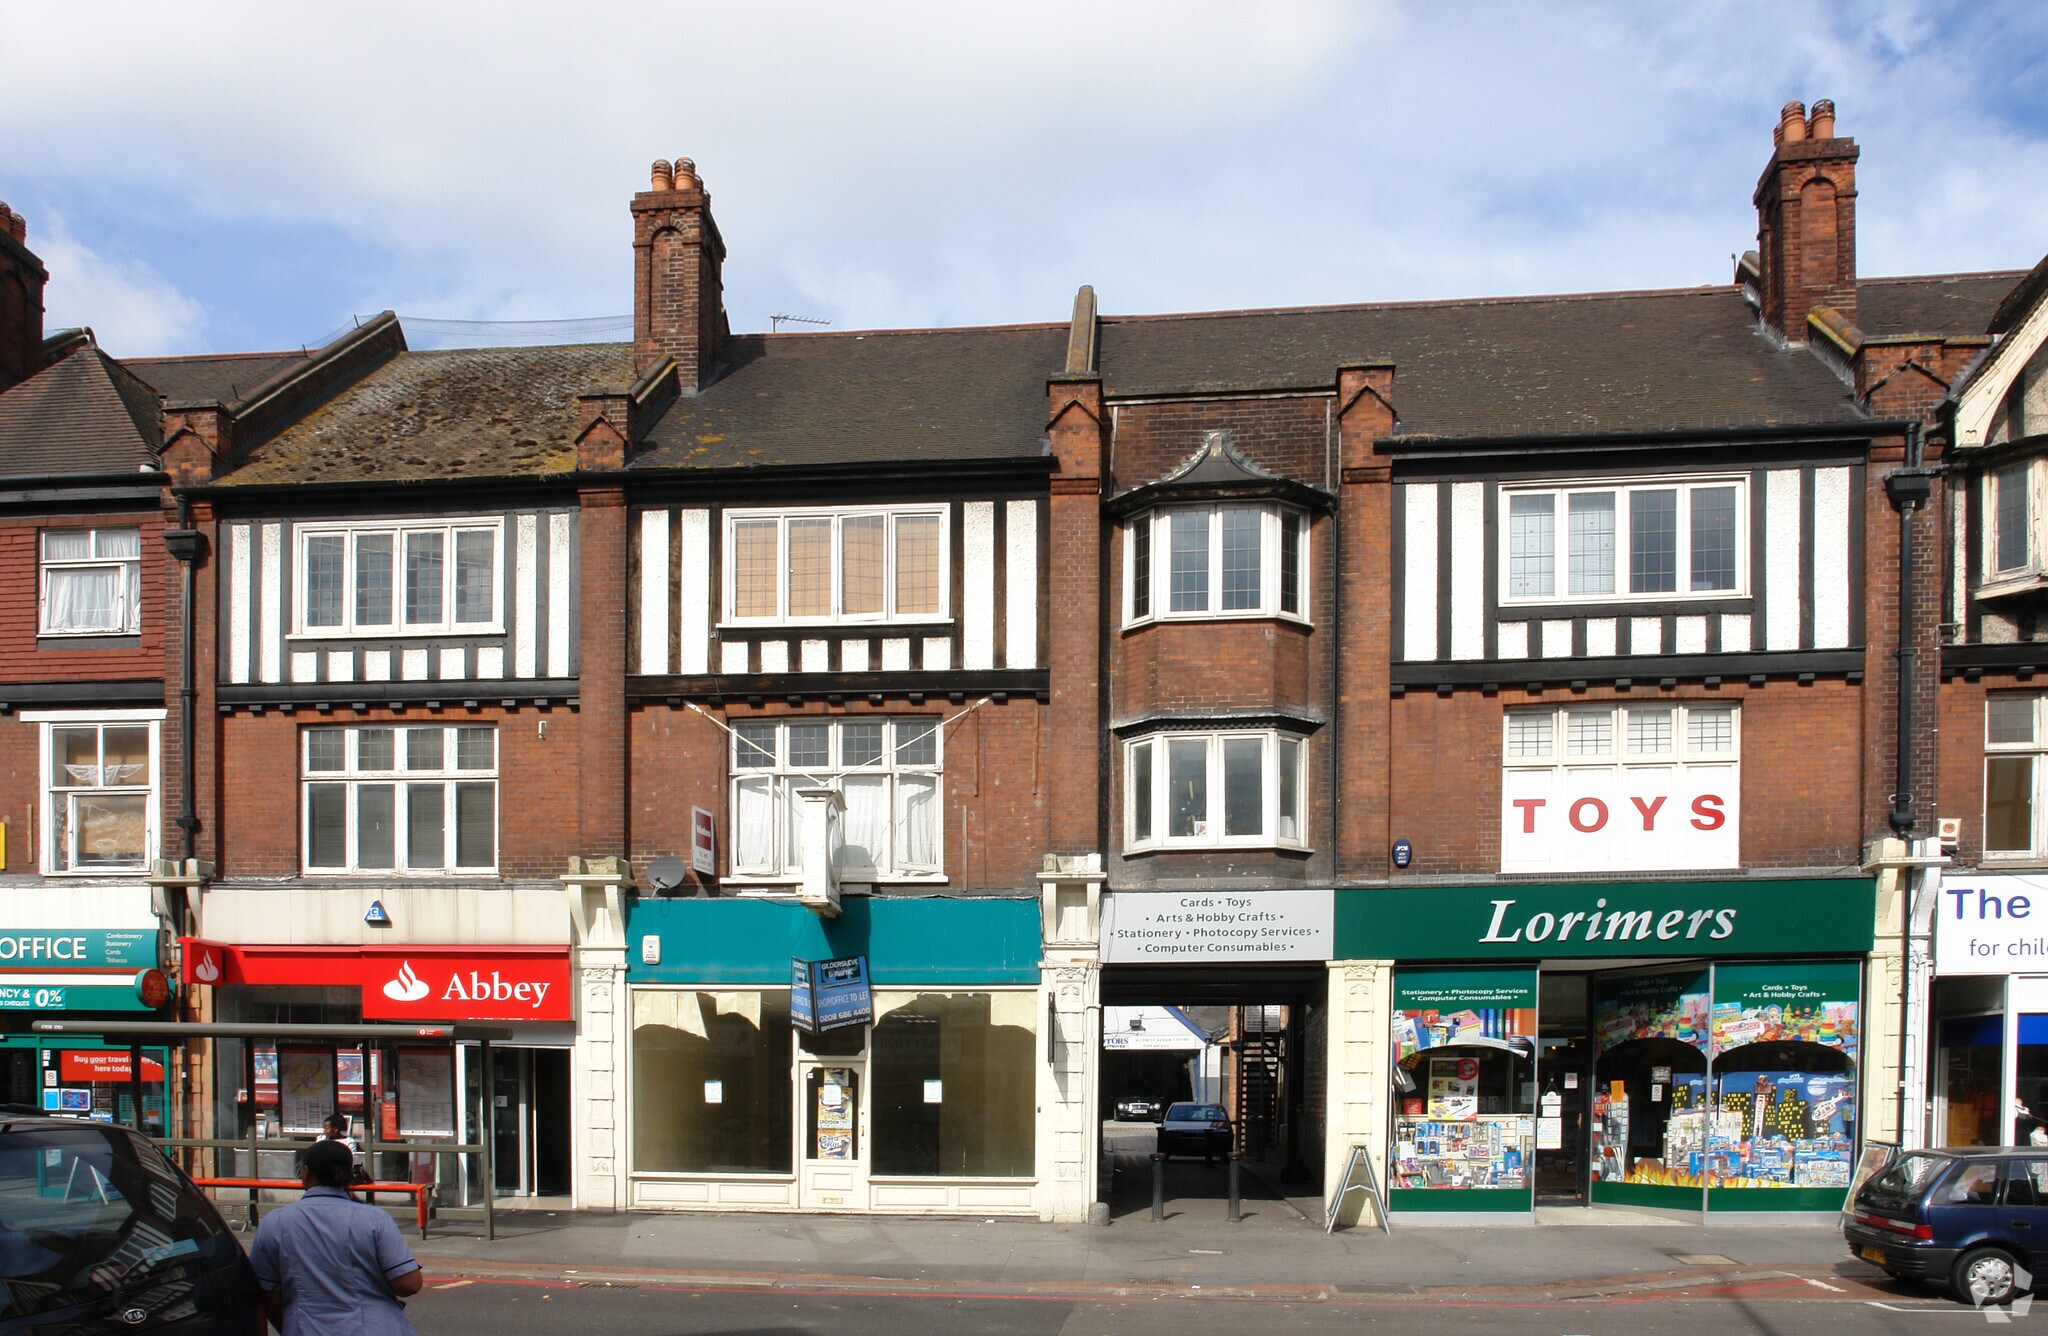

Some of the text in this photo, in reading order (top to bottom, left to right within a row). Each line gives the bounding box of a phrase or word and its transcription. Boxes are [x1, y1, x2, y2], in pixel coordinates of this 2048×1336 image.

[1513, 794, 1725, 833] TOYS
[1180, 898, 1251, 908] Cards Toys
[1946, 888, 2031, 919] The
[1156, 912, 1276, 924] Arts & Hobby Crafts
[1478, 898, 1737, 943] Lorimers
[1117, 927, 1312, 940] Stationery Photocopy Services
[0, 932, 143, 959] OFFICE Confectionery
[1144, 942, 1287, 955] Computer Consumables
[1970, 937, 2048, 956] for chil
[441, 971, 551, 1008] Abbey
[850, 993, 858, 1002] TO
[859, 991, 869, 1000] LET
[1771, 991, 1795, 999] Hobby
[22, 989, 31, 998] &
[35, 989, 62, 1008] 0%
[820, 1007, 870, 1023] 0208 686 4400
[1104, 1037, 1128, 1045] TORS
[74, 1055, 88, 1063] Buy
[90, 1056, 107, 1064] your
[107, 1055, 129, 1063] travel
